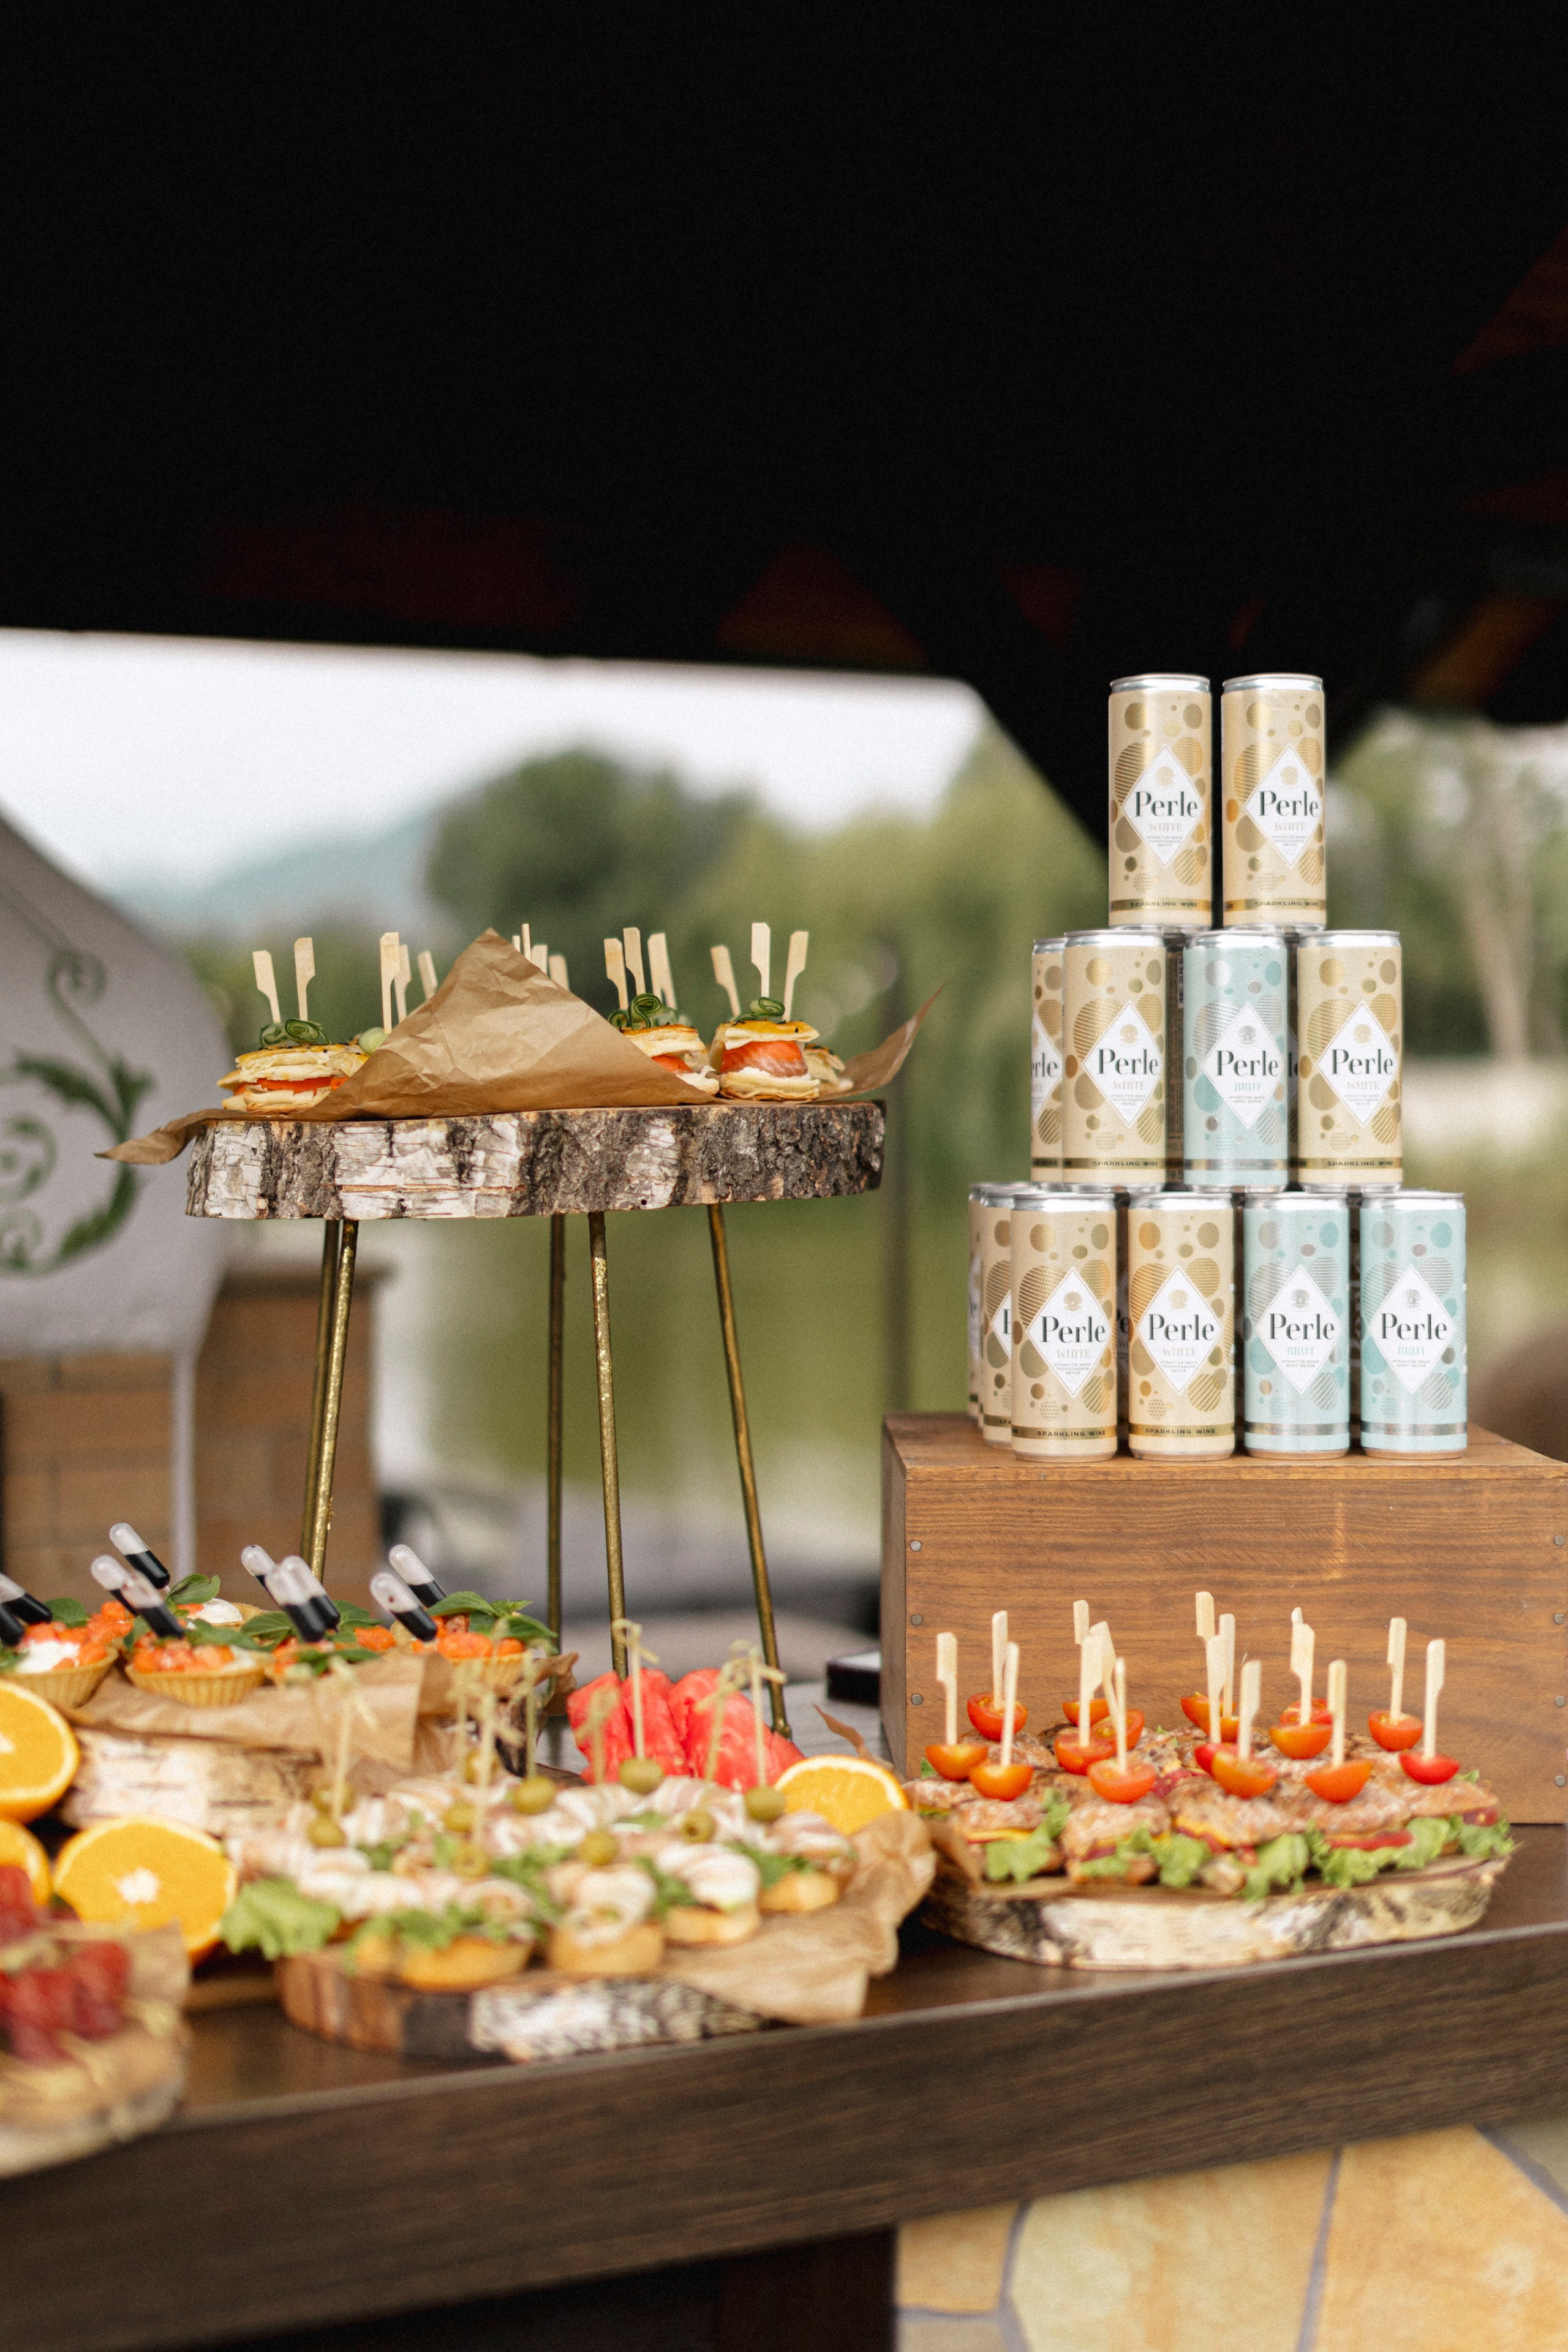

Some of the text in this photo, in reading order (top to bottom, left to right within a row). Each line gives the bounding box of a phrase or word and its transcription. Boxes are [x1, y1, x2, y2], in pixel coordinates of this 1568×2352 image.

[1134, 791, 1197, 817] Perle
[1259, 791, 1318, 817] Perle
[1149, 823, 1182, 832] WHITE
[1275, 823, 1306, 831] WHITE
[1032, 1053, 1058, 1078] rle
[1098, 1048, 1158, 1076] Perle
[1215, 1050, 1278, 1077] Perle
[1331, 1048, 1393, 1075] Perle
[1113, 1081, 1145, 1090] WHITE
[1234, 1082, 1262, 1091] BRUT
[1347, 1081, 1380, 1090] WHITE
[1040, 1316, 1106, 1343] Perle
[1147, 1313, 1215, 1341] Perle
[1269, 1313, 1334, 1340] Perle
[1381, 1313, 1447, 1340] Perle
[1057, 1349, 1091, 1359] WHITE
[1163, 1348, 1197, 1357] WHITE
[1287, 1346, 1316, 1355] BRUT
[1398, 1346, 1427, 1355] BRUT
